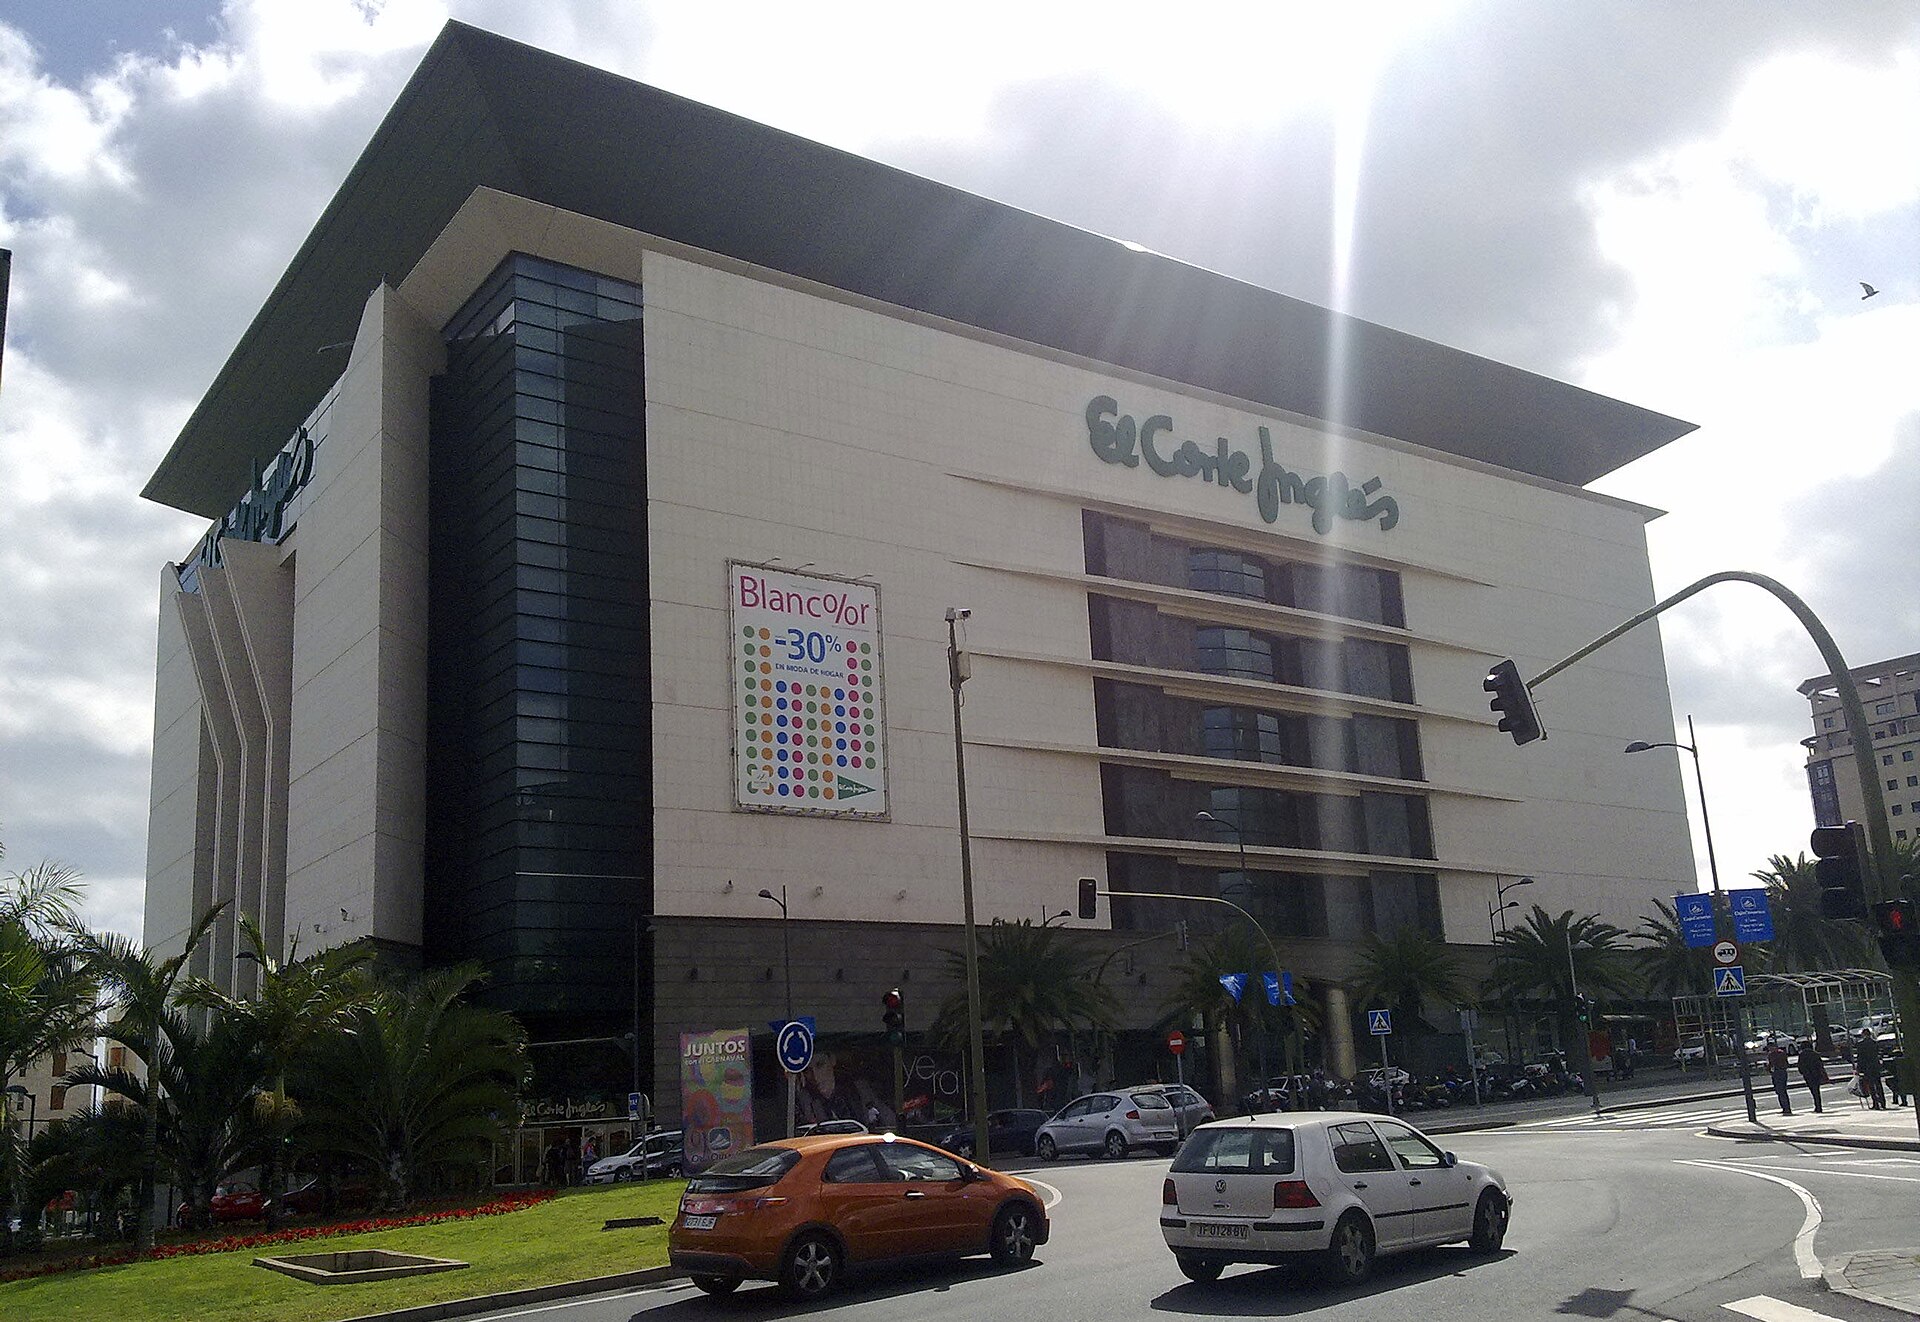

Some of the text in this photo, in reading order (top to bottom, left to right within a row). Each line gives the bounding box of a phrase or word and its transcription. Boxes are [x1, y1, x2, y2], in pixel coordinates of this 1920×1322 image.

[1086, 395, 1399, 535] El Corte Inglés
[775, 628, 841, 663] -30%
[786, 664, 808, 673] MODA
[810, 667, 819, 675] DE
[820, 669, 844, 678] HOGAR
[684, 1040, 746, 1056] JUNTOS
[902, 1055, 959, 1094] yera
